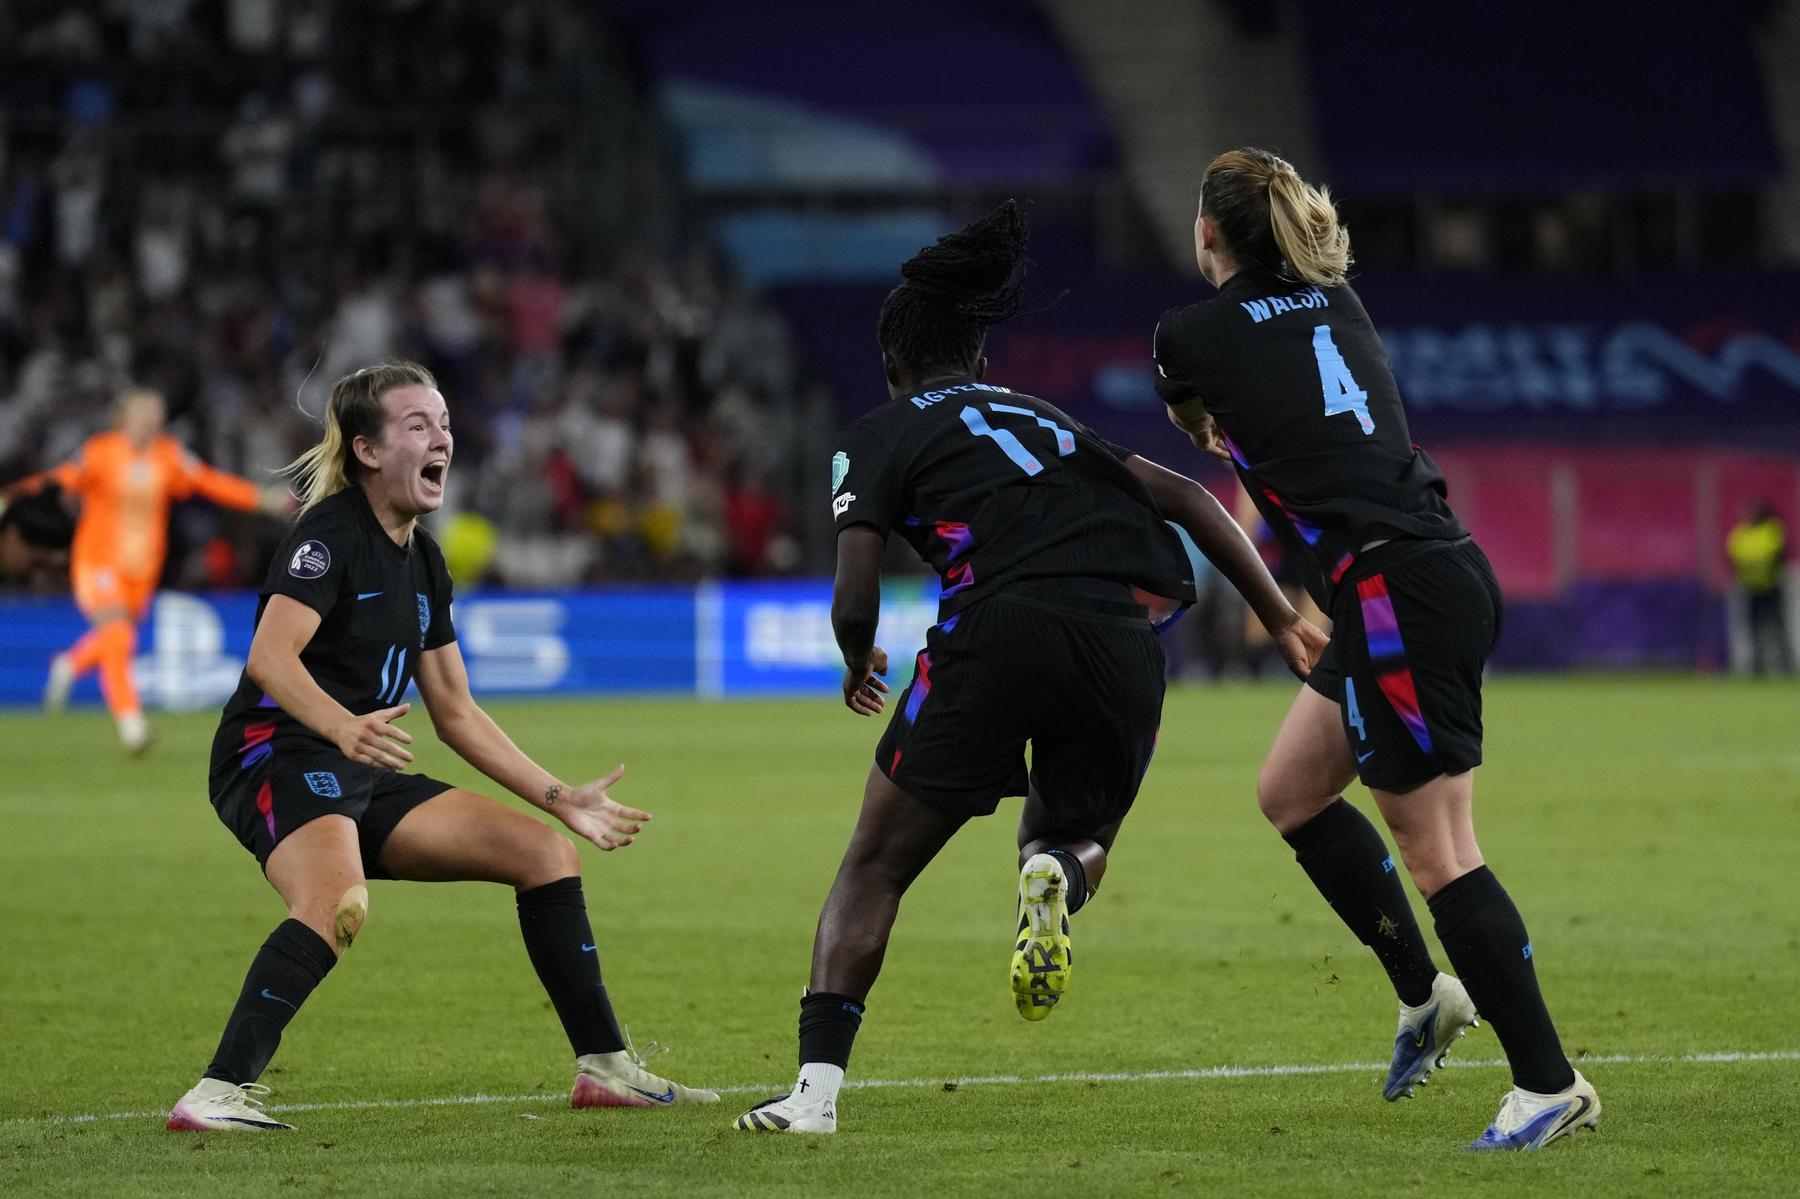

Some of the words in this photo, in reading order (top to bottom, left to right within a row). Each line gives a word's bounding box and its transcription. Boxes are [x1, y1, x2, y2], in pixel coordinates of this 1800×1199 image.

[1240, 284, 1329, 323] WALSH
[1312, 324, 1376, 435] 4
[959, 401, 1076, 477] 17
[376, 644, 407, 704] 11
[1345, 676, 1366, 740] 4
